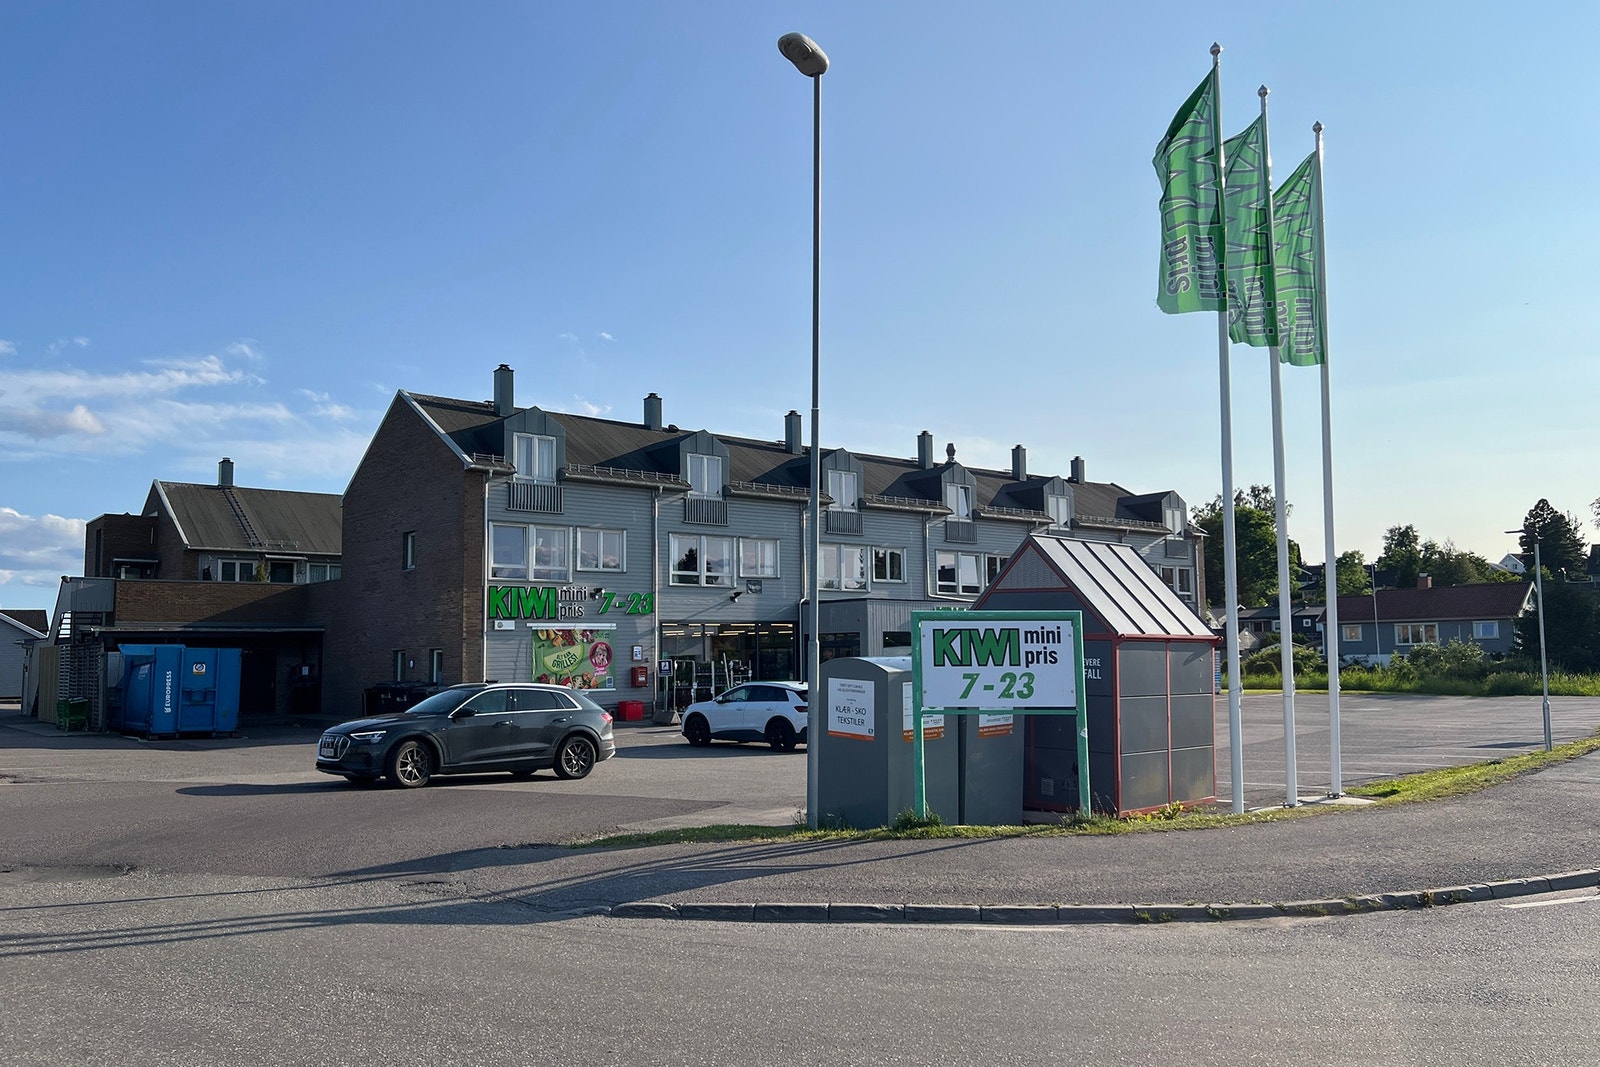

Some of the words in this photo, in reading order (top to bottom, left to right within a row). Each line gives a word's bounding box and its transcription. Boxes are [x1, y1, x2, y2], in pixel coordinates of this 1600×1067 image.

[1164, 236, 1195, 296] pris
[1194, 235, 1227, 300] mini
[1243, 275, 1274, 337] mini
[1294, 297, 1321, 356] mini
[488, 586, 557, 620] KIWI
[558, 586, 588, 601] mini
[558, 602, 585, 621] pris
[932, 628, 1021, 667] KIWI
[1024, 626, 1062, 644] mini
[1025, 646, 1058, 669] pris
[835, 705, 851, 714] KLÆR
[854, 707, 867, 716] SKO
[837, 716, 865, 726] TEKSTILER
